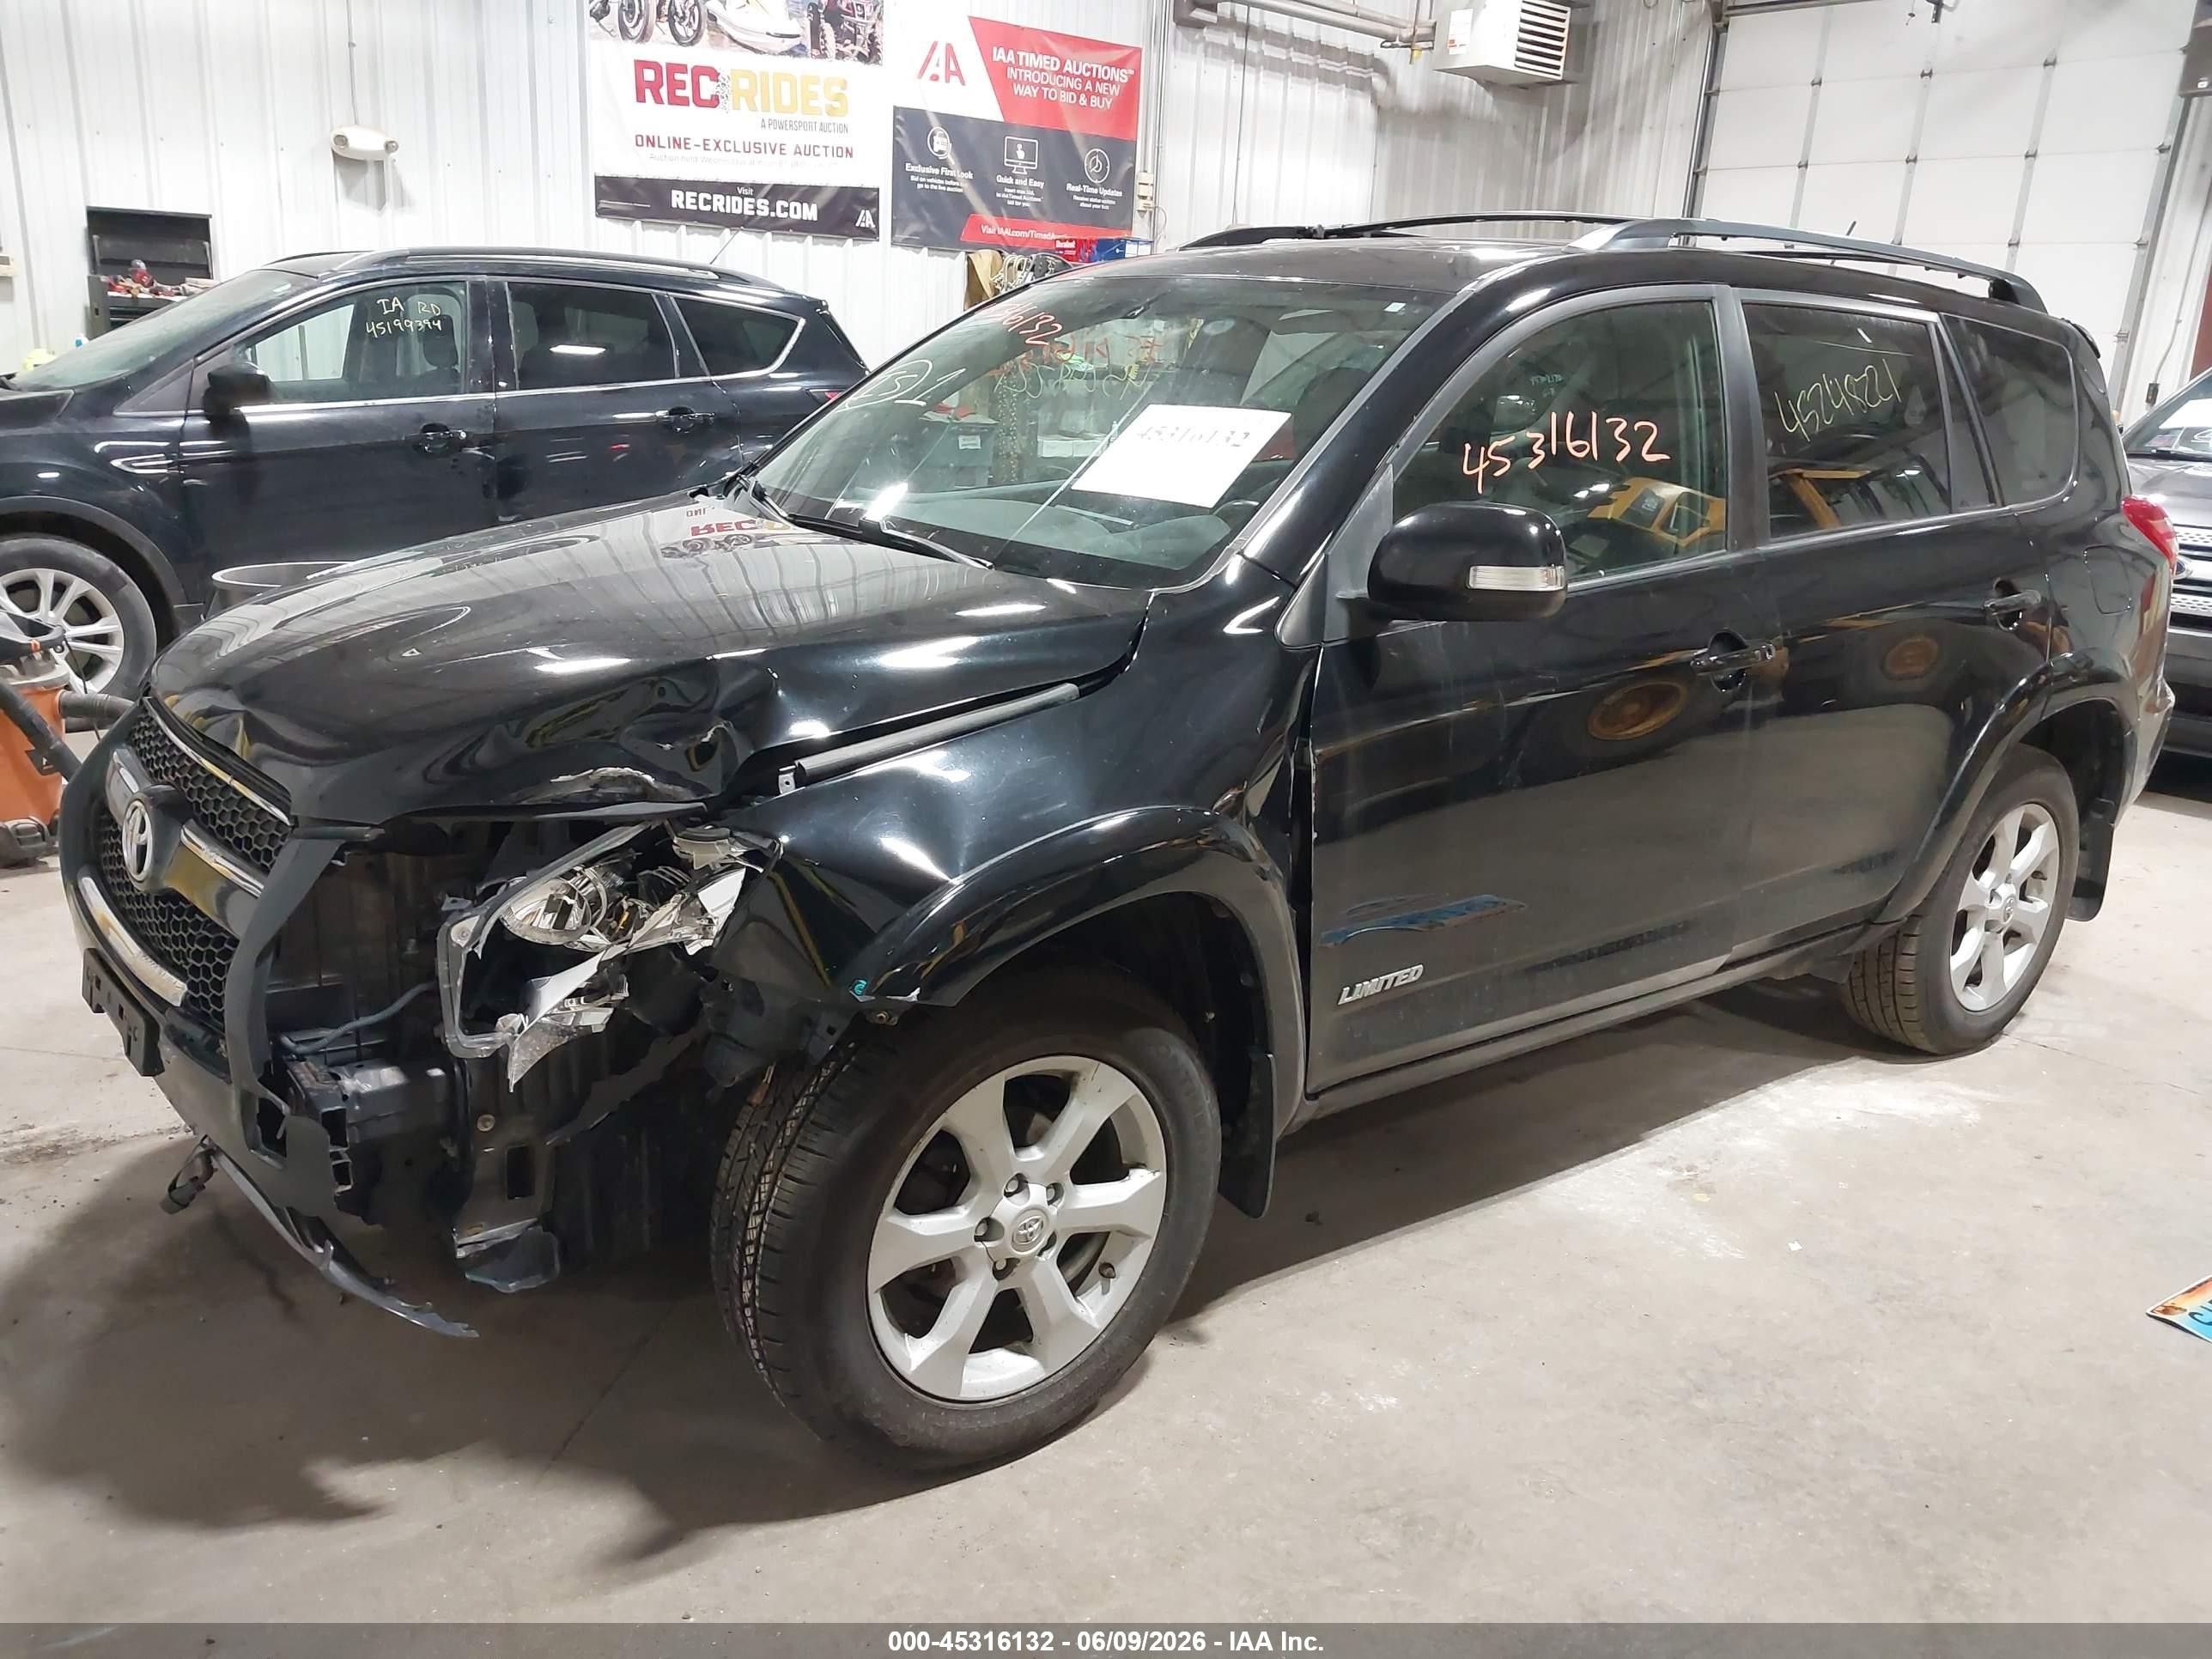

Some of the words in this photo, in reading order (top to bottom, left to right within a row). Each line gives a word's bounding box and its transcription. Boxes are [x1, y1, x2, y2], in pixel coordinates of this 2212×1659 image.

[993, 46, 1015, 64] IAA
[1017, 51, 1060, 71] TIMED
[1006, 67, 1082, 90] INTRODUCING
[1085, 82, 1093, 92] A
[1095, 82, 1121, 97] NEW
[1013, 83, 1040, 98] WAY
[1042, 87, 1058, 101] TO
[1060, 91, 1077, 105] BID
[1079, 94, 1088, 107] &
[1090, 95, 1113, 110] BUY
[761, 118, 766, 130] A
[768, 118, 817, 132] POWERSPORT
[818, 121, 849, 134] AUCTION
[635, 134, 787, 155] ONLINE-EXCLUSIVE
[793, 144, 854, 159] AUCTION
[905, 162, 940, 175] Exclusive
[940, 167, 957, 177] First
[737, 186, 754, 196] Visit
[996, 174, 1014, 185] Quick
[1015, 178, 1028, 186] and
[1029, 178, 1045, 189] Easy
[1066, 182, 1098, 195] Real-Time
[1099, 187, 1123, 198] Updates
[671, 189, 818, 222] RECRIDES.COM
[981, 224, 996, 234] Visit
[1337, 963, 1425, 1006] LIMITED
